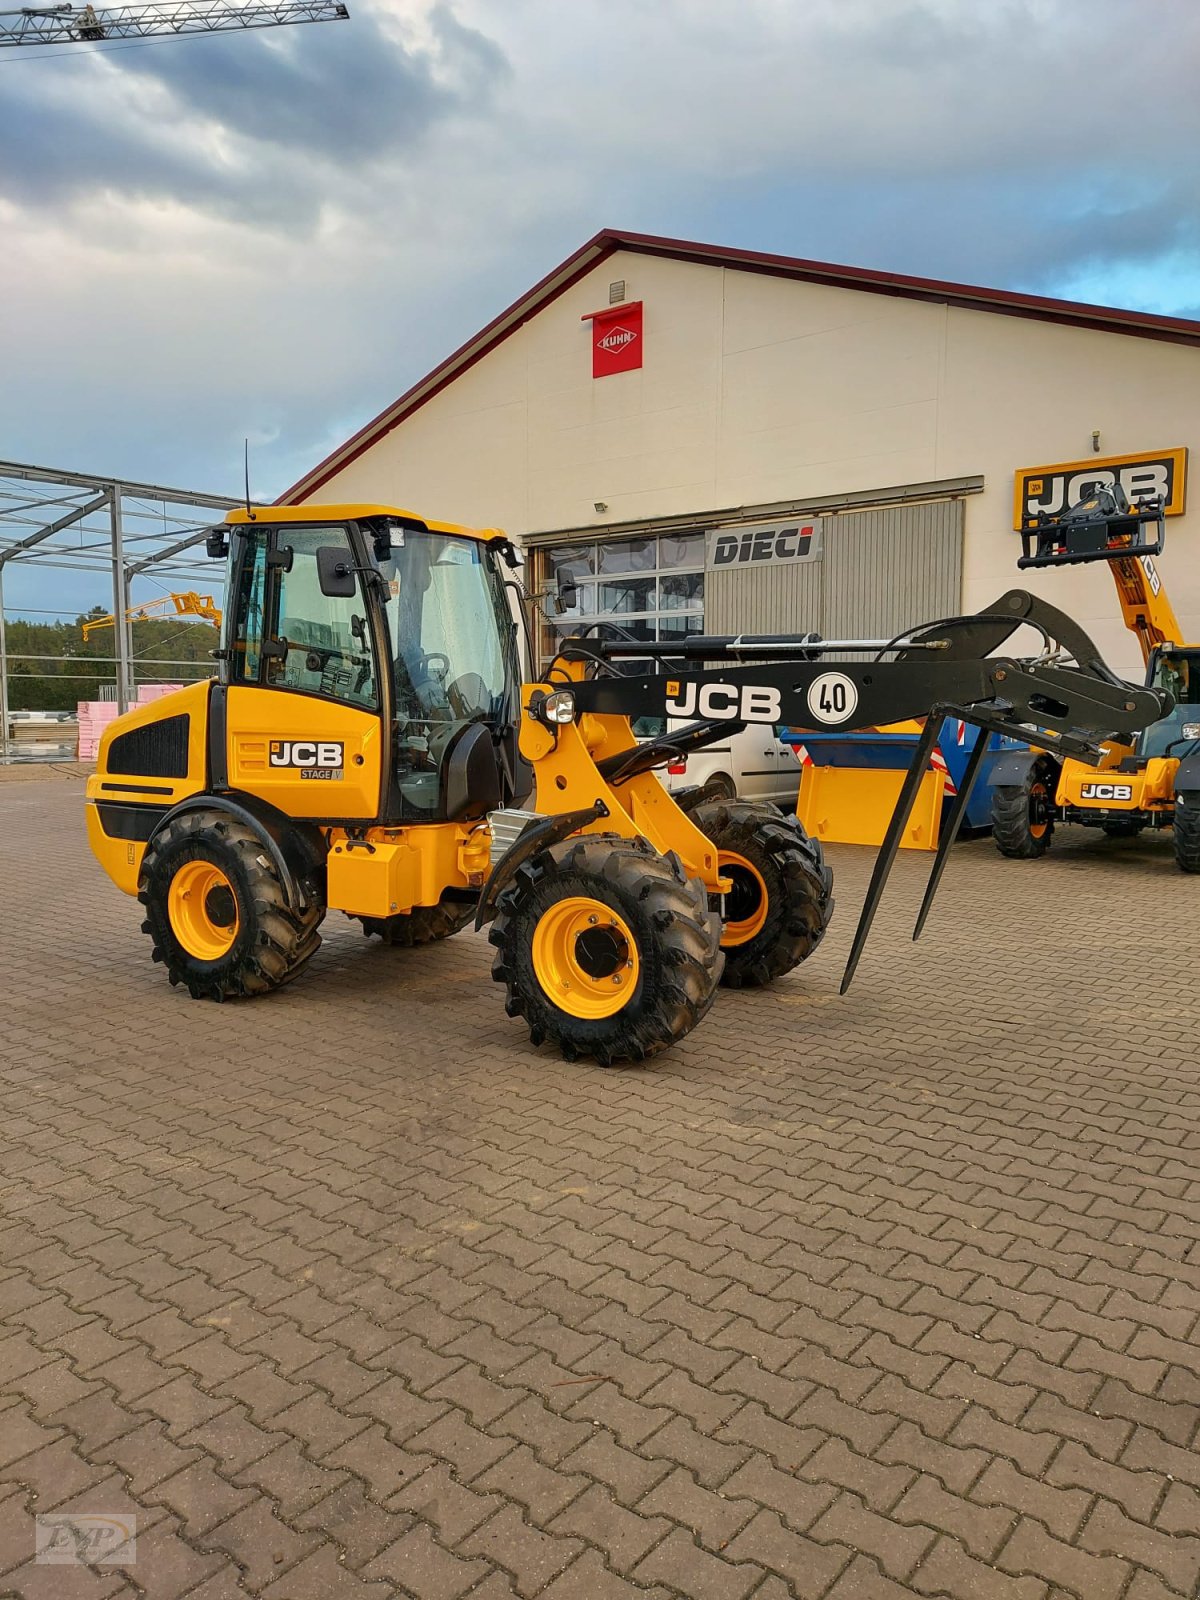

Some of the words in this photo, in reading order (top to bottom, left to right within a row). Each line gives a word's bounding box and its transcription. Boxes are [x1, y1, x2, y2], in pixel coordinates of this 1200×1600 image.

[602, 332, 631, 348] KUHN
[665, 682, 781, 723] JCB
[819, 683, 846, 713] 40
[271, 743, 342, 767] JCB
[302, 770, 331, 779] STAGE
[1082, 785, 1131, 800] JCB
